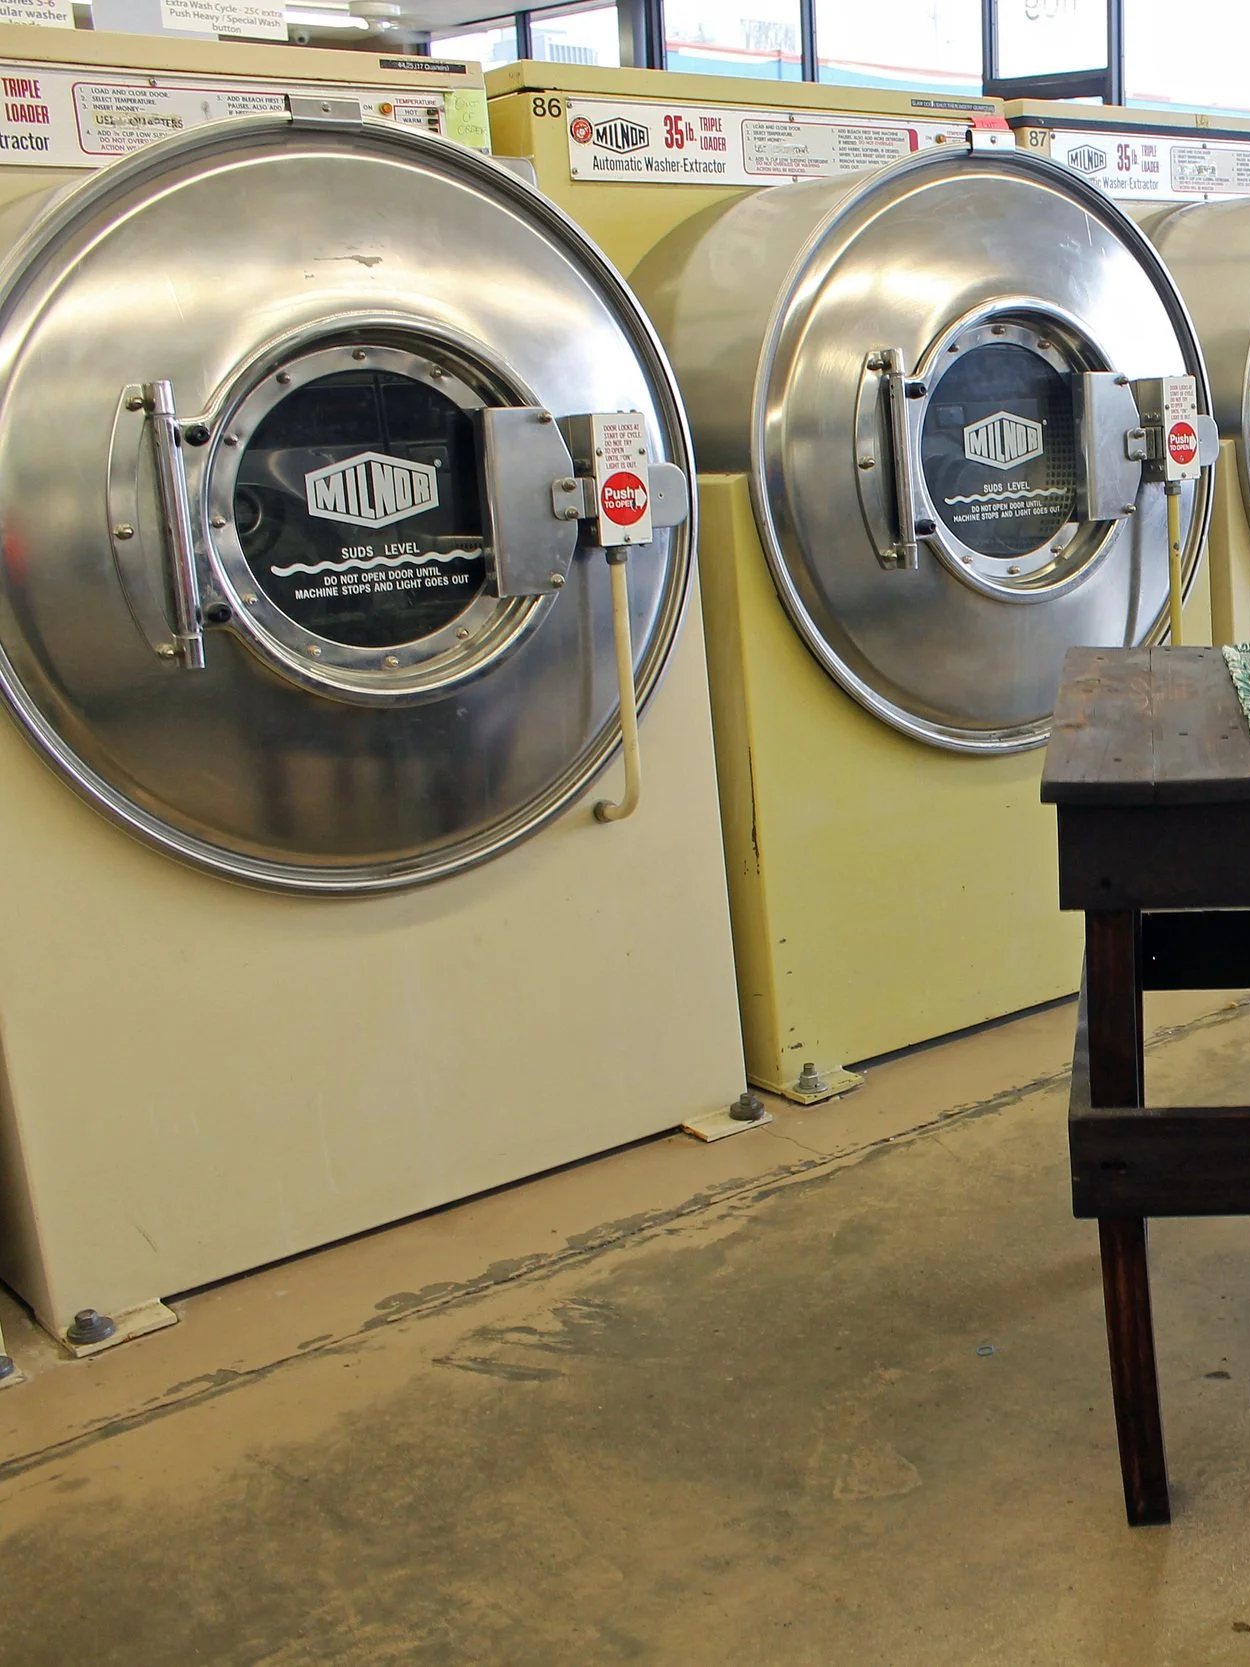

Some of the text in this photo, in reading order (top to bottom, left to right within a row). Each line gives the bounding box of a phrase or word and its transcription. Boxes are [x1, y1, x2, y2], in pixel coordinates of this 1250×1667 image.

[25, 10, 68, 21] washer
[170, 9, 191, 18] Push
[193, 11, 220, 22] Heavy
[227, 15, 257, 25] Special
[258, 18, 281, 27] Wash
[189, 1, 212, 10] Wash
[215, 4, 237, 13] Cycle
[261, 10, 282, 18] extra
[212, 24, 242, 33] button
[1, 78, 42, 99] TRIPLE
[394, 98, 436, 106] TEMPERATURE
[532, 98, 562, 118] 86
[5, 103, 51, 124] LOADER
[663, 114, 697, 150] 35 lb.
[699, 116, 722, 133] TRIPLE
[596, 125, 646, 149] MILNOR
[700, 136, 727, 152] LOADER
[1030, 131, 1047, 148] 87
[593, 156, 727, 174] Automatic Washer-Extractor
[1070, 148, 1104, 171] MILNOR
[1116, 143, 1130, 172] 35
[604, 432, 618, 440] START
[970, 418, 1038, 463] MILNOR
[1170, 434, 1189, 444] Push
[1177, 444, 1190, 452] OPEN
[314, 460, 432, 520] MILNOR
[604, 486, 636, 500] Push
[984, 481, 1030, 494] SUDS LEVEL
[604, 500, 615, 509] TO
[980, 504, 992, 512] NOT
[992, 502, 1008, 511] OPEN
[1010, 502, 1025, 510] DOOR
[1026, 500, 1042, 508] UNTIL
[953, 505, 1060, 523] MACHINE STOPS AND LIGHT GOES OUT
[341, 542, 420, 560] SUDS LEVEL
[324, 567, 442, 586] DO NOT OPEN DOOR UNTIL
[295, 574, 470, 600] MACHINE STOPS AND LIGHT GOES OUT
